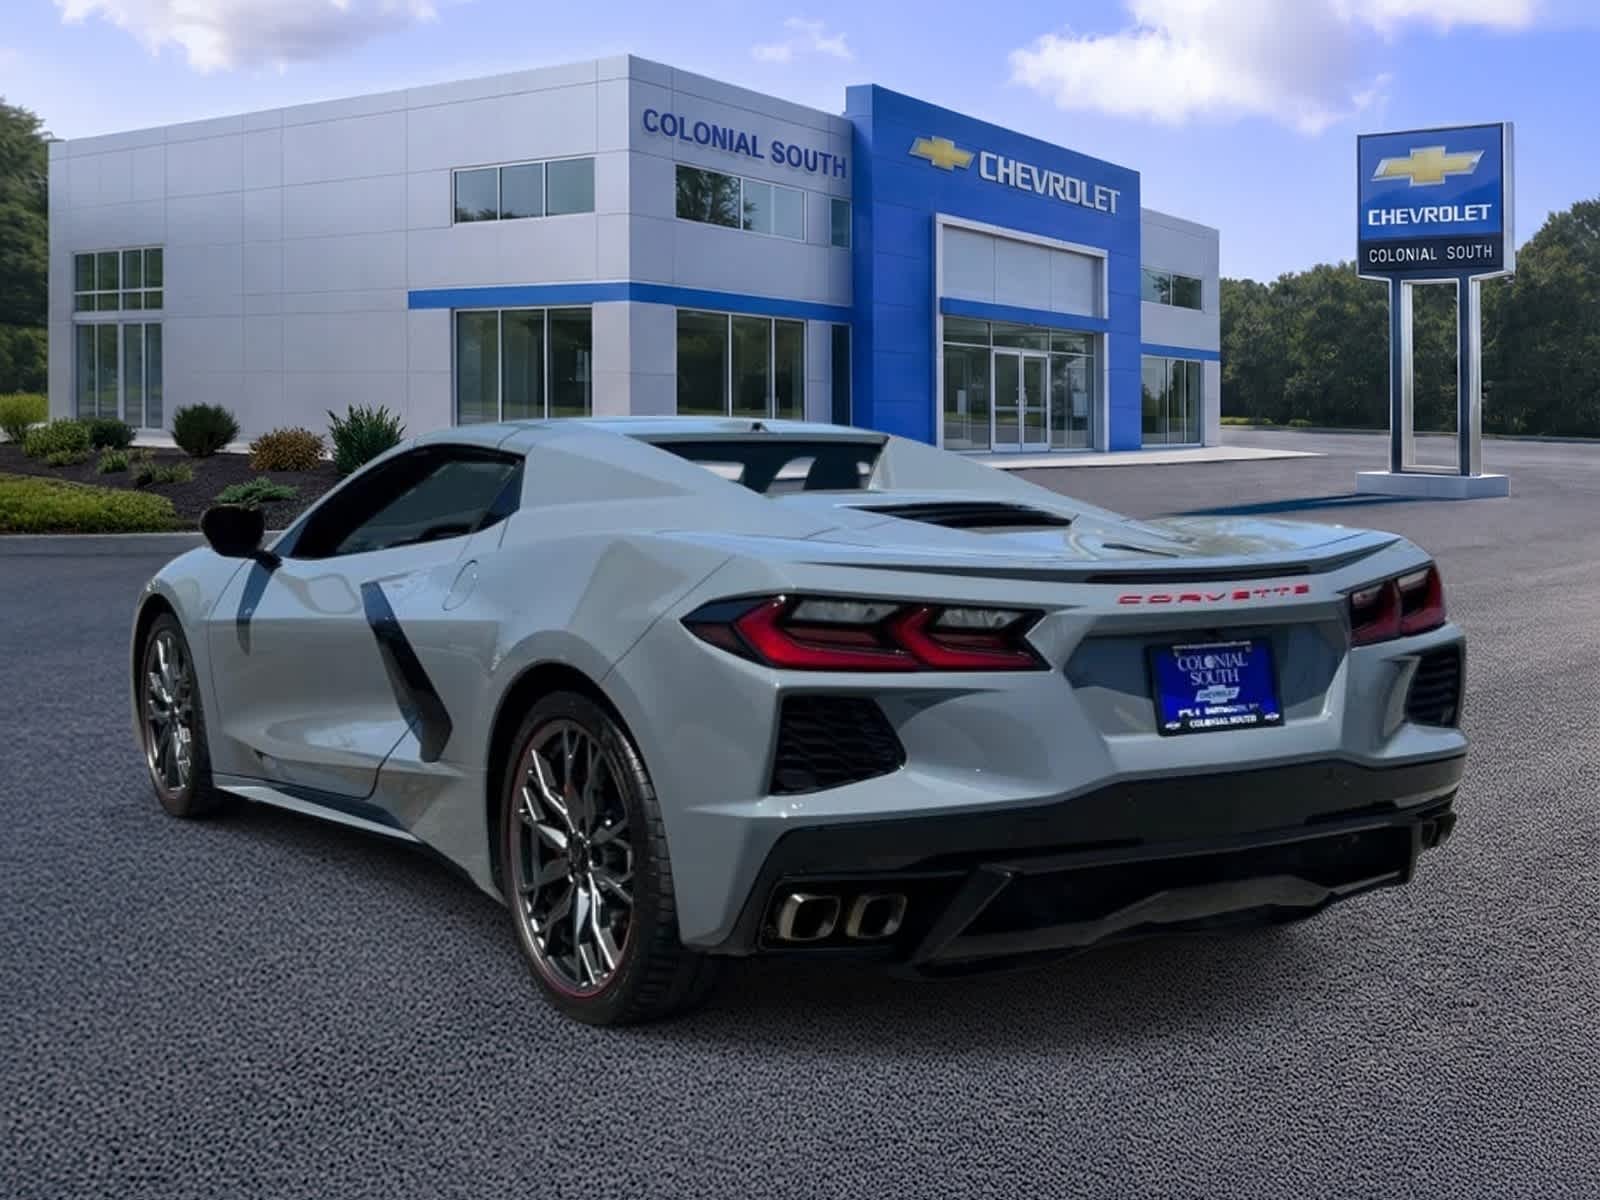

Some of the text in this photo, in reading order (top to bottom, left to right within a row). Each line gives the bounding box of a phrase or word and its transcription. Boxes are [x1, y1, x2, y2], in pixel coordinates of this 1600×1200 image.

[643, 109, 848, 178] COLONIAL SOUTH
[979, 151, 1121, 214] CHEVROLET
[1368, 203, 1492, 226] CHEVROLET
[1369, 244, 1493, 263] COLONIAL SOUTH
[1118, 584, 1310, 605] CORVETTE
[1177, 652, 1248, 672] COLONIAL
[1190, 668, 1241, 686] SOUTH
